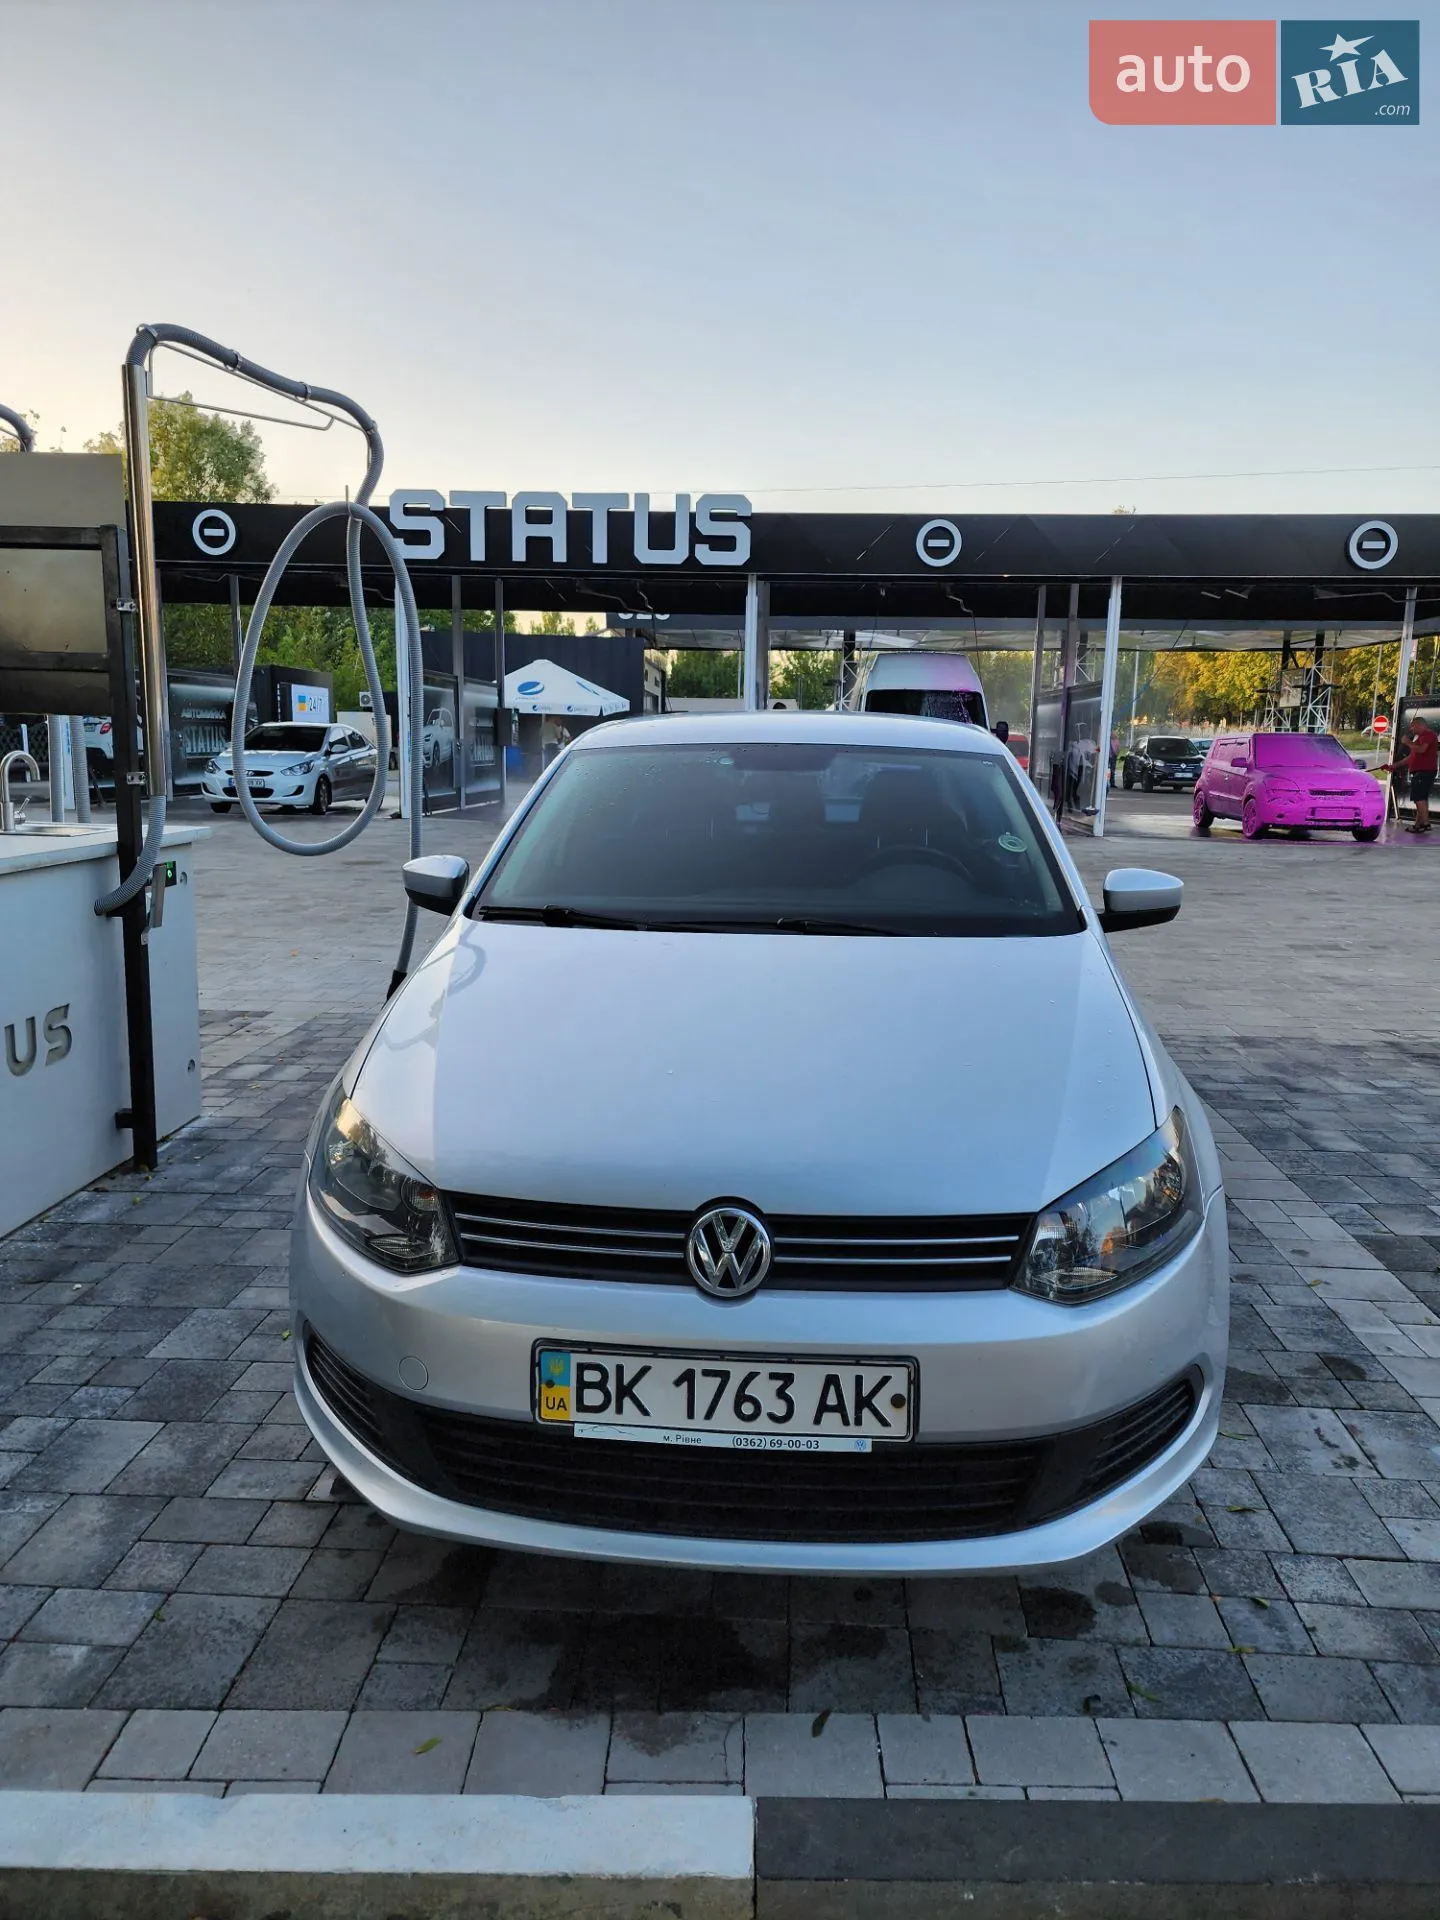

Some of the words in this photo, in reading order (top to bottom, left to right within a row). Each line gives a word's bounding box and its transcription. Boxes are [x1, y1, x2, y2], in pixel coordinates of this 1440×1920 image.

[389, 489, 753, 566] STATUS
[4, 1003, 72, 1077] US
[545, 1396, 567, 1412] UA
[576, 1361, 652, 1417] BK
[672, 1367, 795, 1424] 1763
[812, 1373, 892, 1427] AK
[675, 1434, 702, 1445] Рівне
[732, 1435, 767, 1449] (0362)
[769, 1439, 820, 1450] 69-00-03
